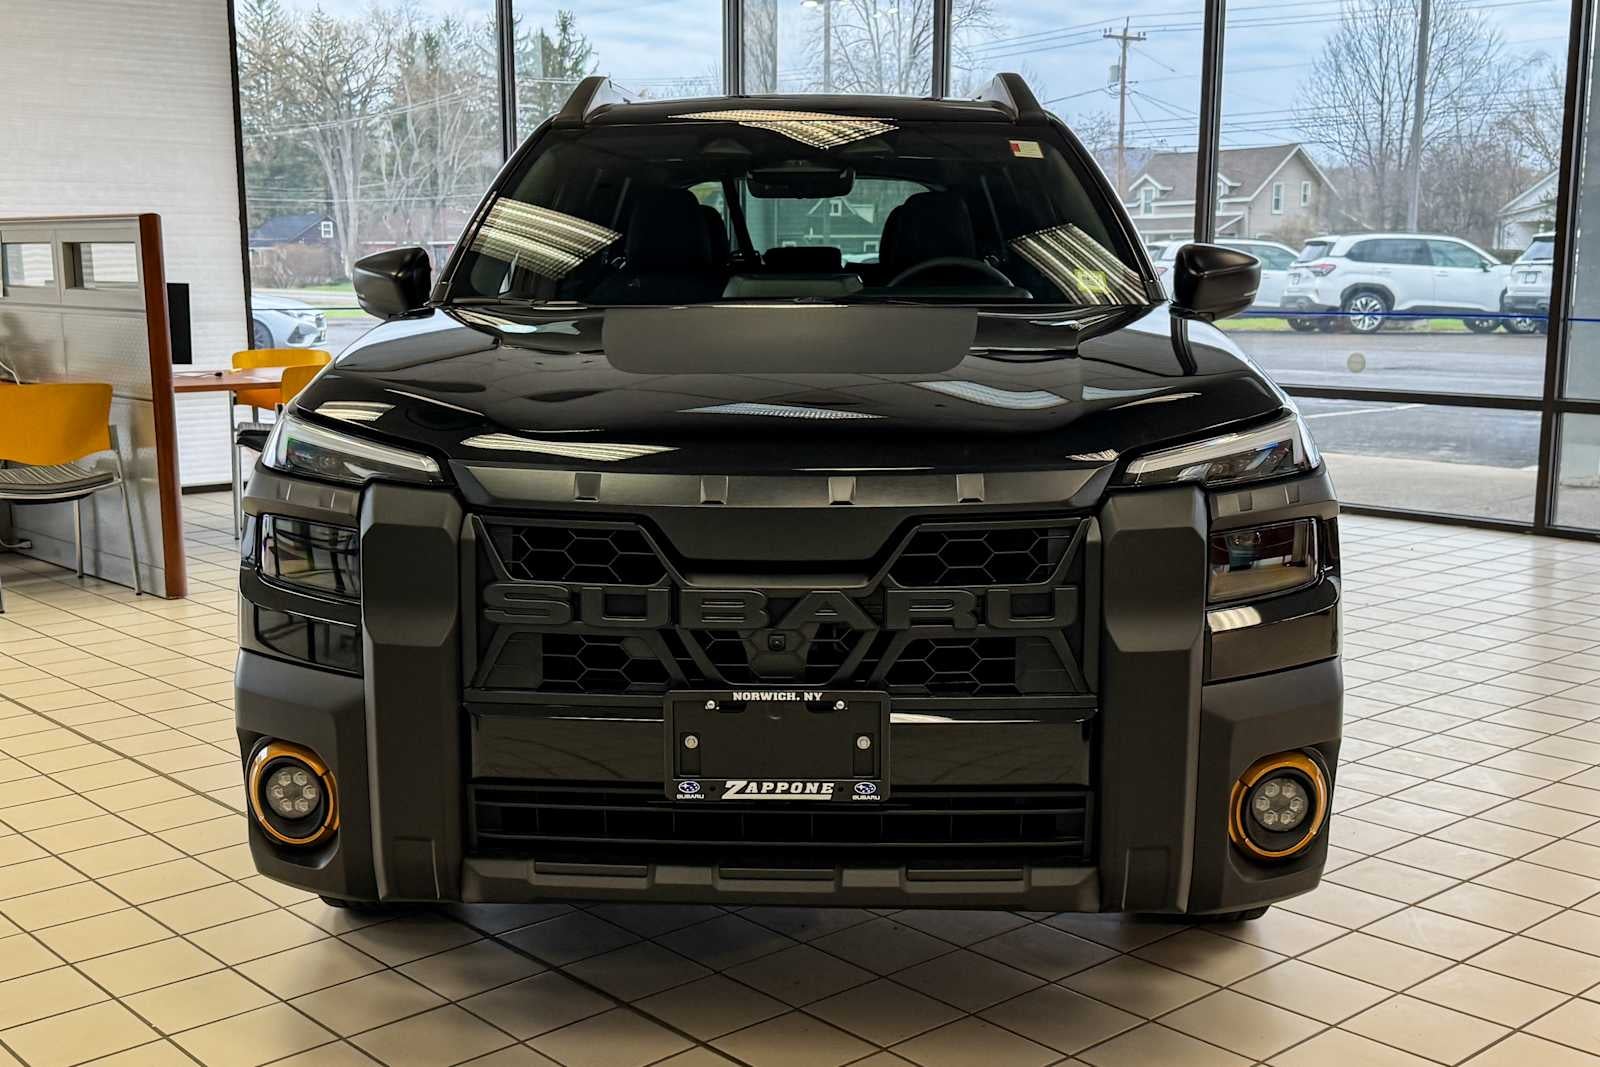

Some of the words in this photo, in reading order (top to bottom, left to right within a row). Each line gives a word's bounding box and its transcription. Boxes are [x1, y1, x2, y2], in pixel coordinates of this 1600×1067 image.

[483, 583, 1078, 631] SUBARU
[803, 692, 823, 701] NY
[721, 781, 835, 800] ZAPPONE
